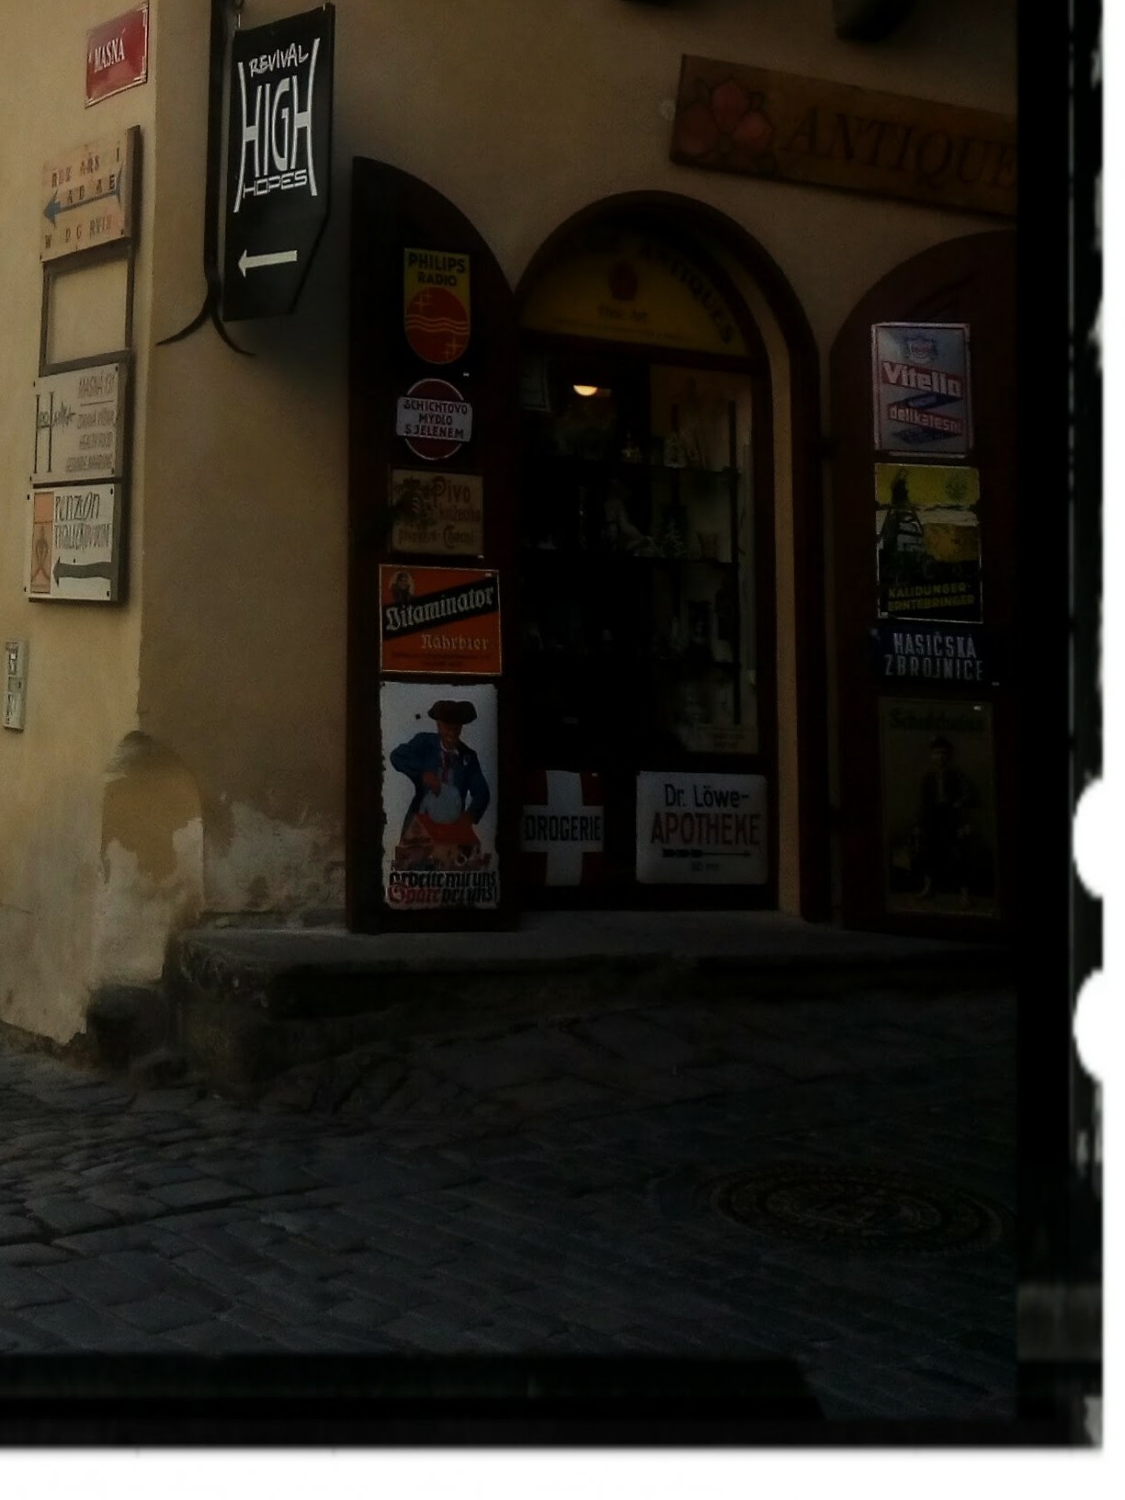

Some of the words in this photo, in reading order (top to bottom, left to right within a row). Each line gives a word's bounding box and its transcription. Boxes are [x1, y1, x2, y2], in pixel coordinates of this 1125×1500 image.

[249, 43, 309, 78] REVIVAL
[233, 37, 320, 213] HIGH
[243, 169, 308, 199] HOPES
[408, 252, 465, 273] PHILIPS
[418, 271, 457, 286] RADIO
[883, 362, 962, 397] Vitello
[414, 425, 464, 439] JELENEM
[385, 586, 495, 631] Vitaminator
[884, 654, 984, 681] ZBROJNICE
[663, 784, 686, 808] Dr.
[524, 815, 602, 842] DROGERIE
[651, 812, 761, 846] APOTHEKE
